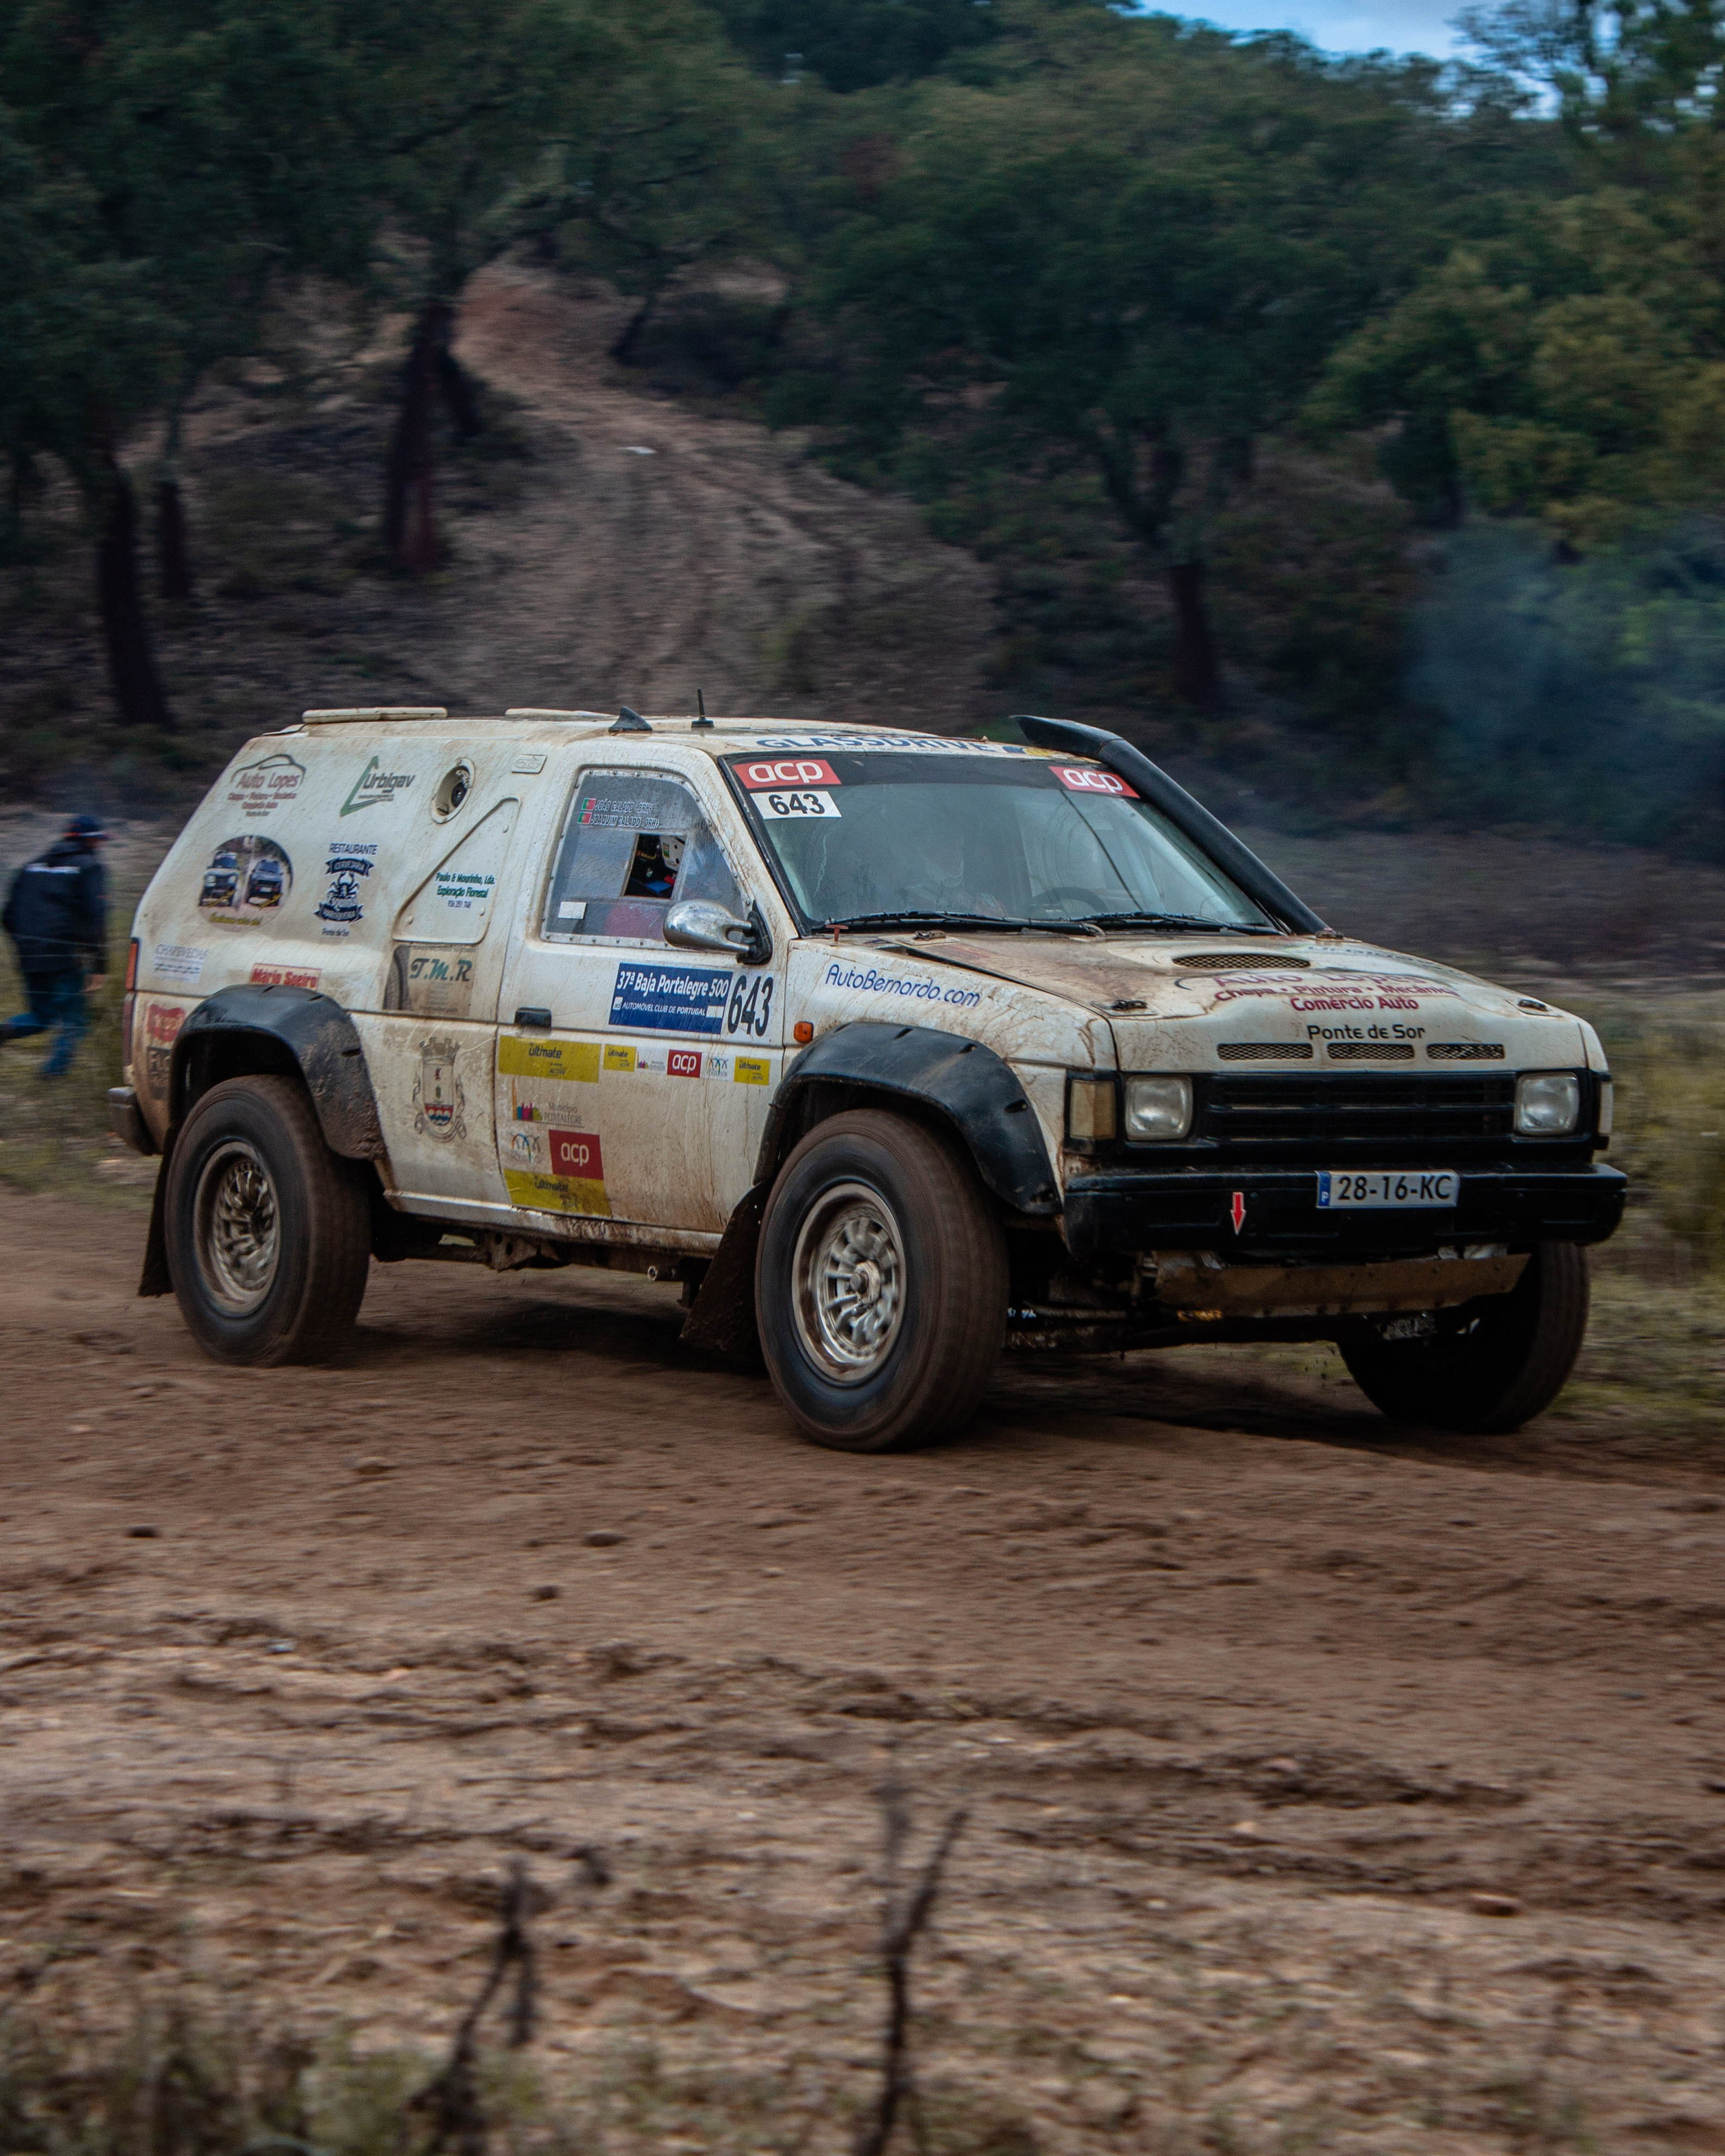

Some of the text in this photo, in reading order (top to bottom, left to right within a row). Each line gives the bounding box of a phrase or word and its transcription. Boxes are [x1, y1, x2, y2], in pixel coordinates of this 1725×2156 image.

[756, 736, 997, 753] GLASSDRIVE
[235, 771, 300, 792] Auto Lopes
[363, 772, 416, 793] Urbigav
[748, 762, 823, 783] acp
[1063, 769, 1123, 793] acp
[768, 793, 825, 815] 643
[328, 842, 379, 855] RESTAURANTE
[634, 972, 656, 996] Baja
[656, 974, 708, 1001] Portalegre
[709, 978, 729, 998] 500
[825, 963, 981, 1008] AutoBernardo.com
[1214, 973, 1426, 987] Auto Lopes
[1292, 985, 1363, 995] Pintura
[622, 1001, 654, 1011] AUTOMÓVEL
[654, 1004, 668, 1013] CLUB
[668, 1005, 676, 1014] DE
[676, 1006, 705, 1016] PORTUGAL
[728, 975, 774, 1037] 643
[1291, 995, 1419, 1011] Comércio Auto
[1307, 1023, 1426, 1040] Ponte de Sor
[672, 1053, 697, 1074] acp
[561, 1142, 590, 1167] acp
[1338, 1174, 1452, 1201] 28-16-KC
